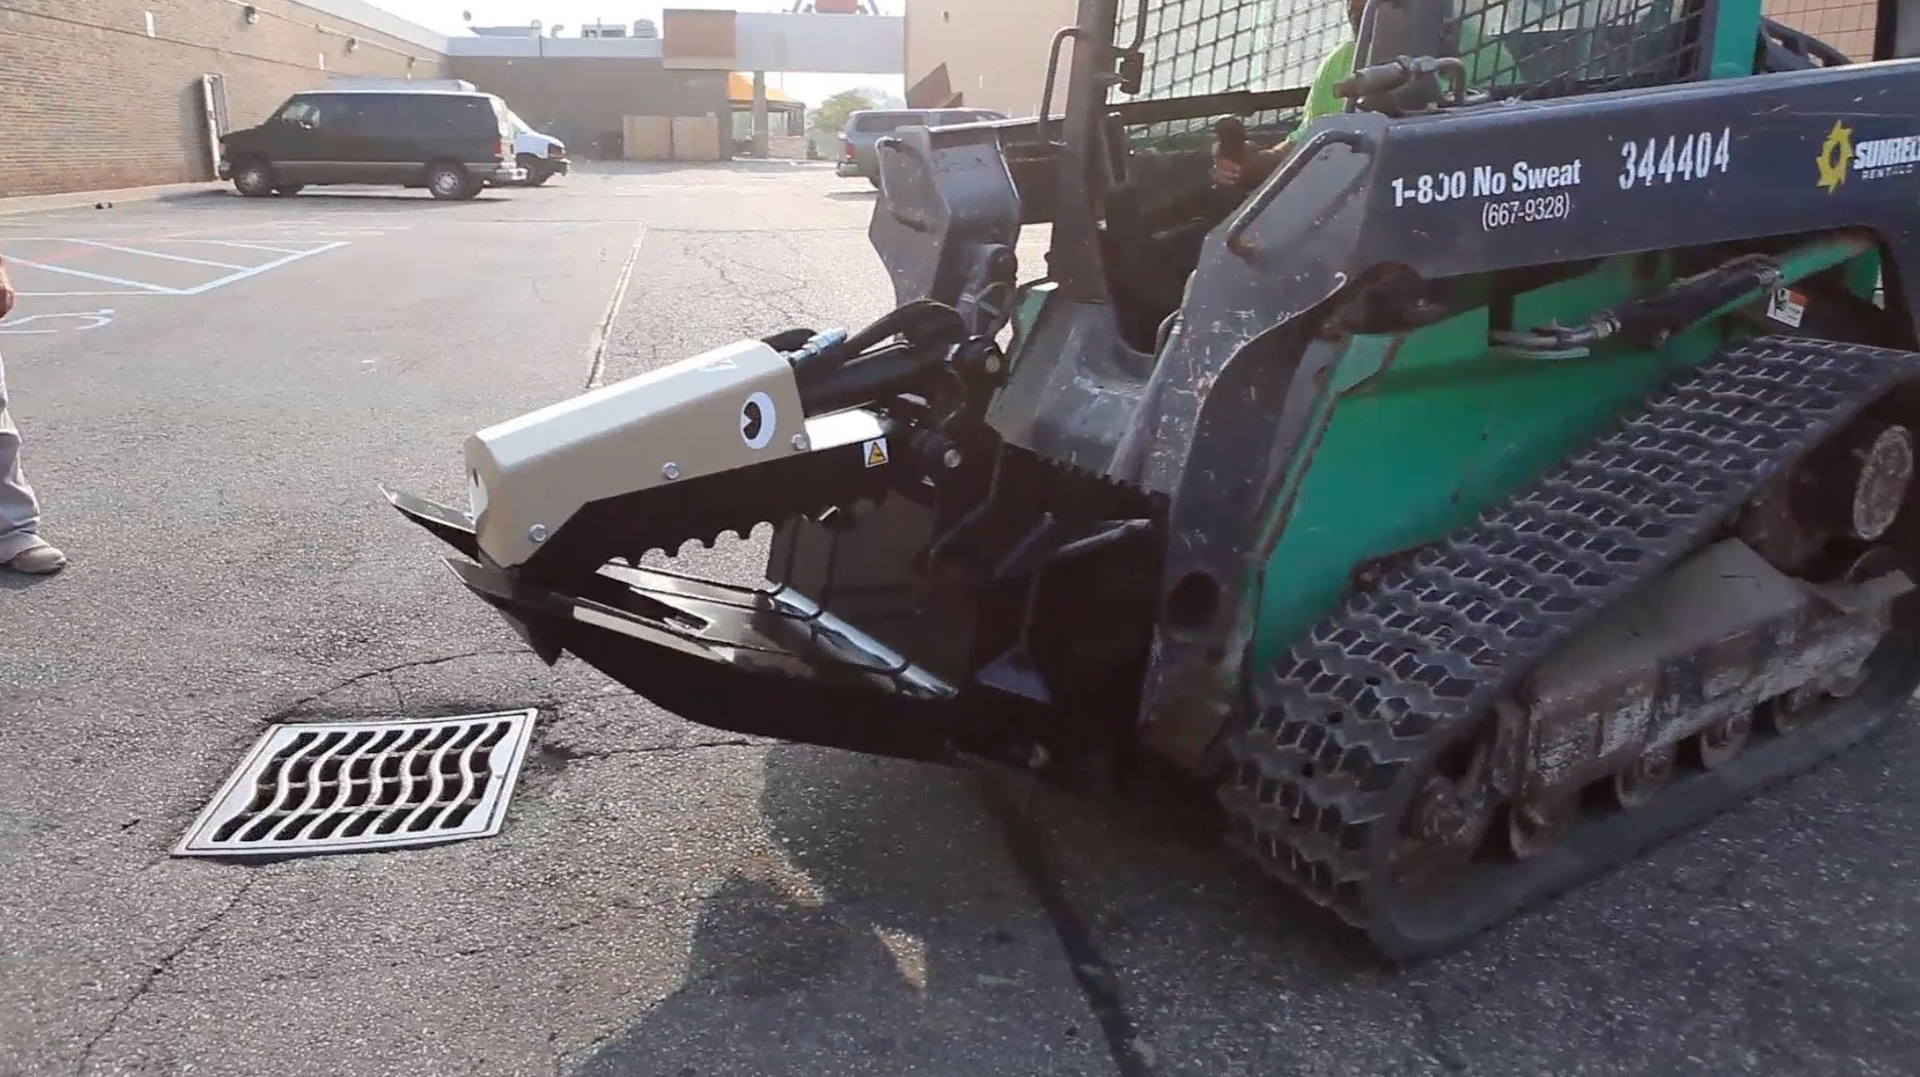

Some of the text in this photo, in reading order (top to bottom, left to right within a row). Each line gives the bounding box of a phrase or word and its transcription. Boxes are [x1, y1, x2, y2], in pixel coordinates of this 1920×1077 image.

[1619, 127, 1731, 189] 344404
[1853, 135, 1920, 169] SUNBEL
[1472, 166, 1506, 197] No
[1512, 159, 1582, 192] Sweat
[1482, 193, 1570, 231] (667-9328)
